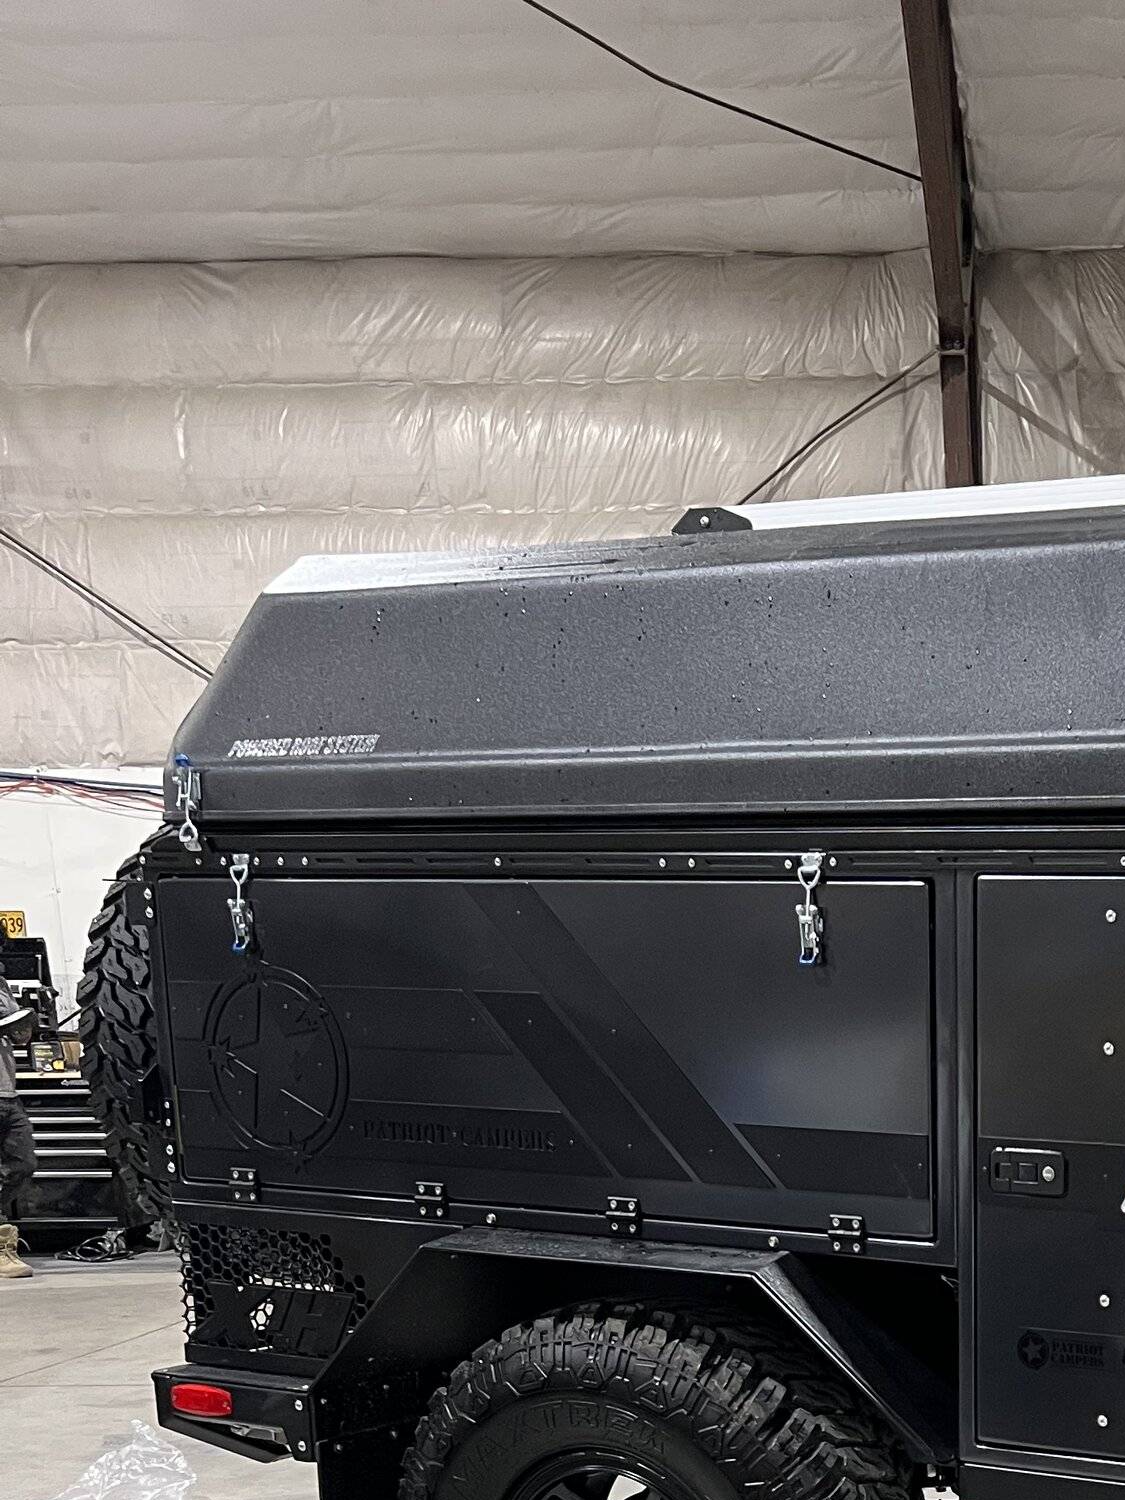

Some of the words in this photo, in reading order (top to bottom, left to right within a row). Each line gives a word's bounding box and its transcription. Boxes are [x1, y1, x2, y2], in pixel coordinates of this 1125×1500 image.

[324, 734, 380, 755] SYSTEM
[364, 1120, 449, 1144] PATRIOT
[1052, 1341, 1104, 1357] PATRIOT
